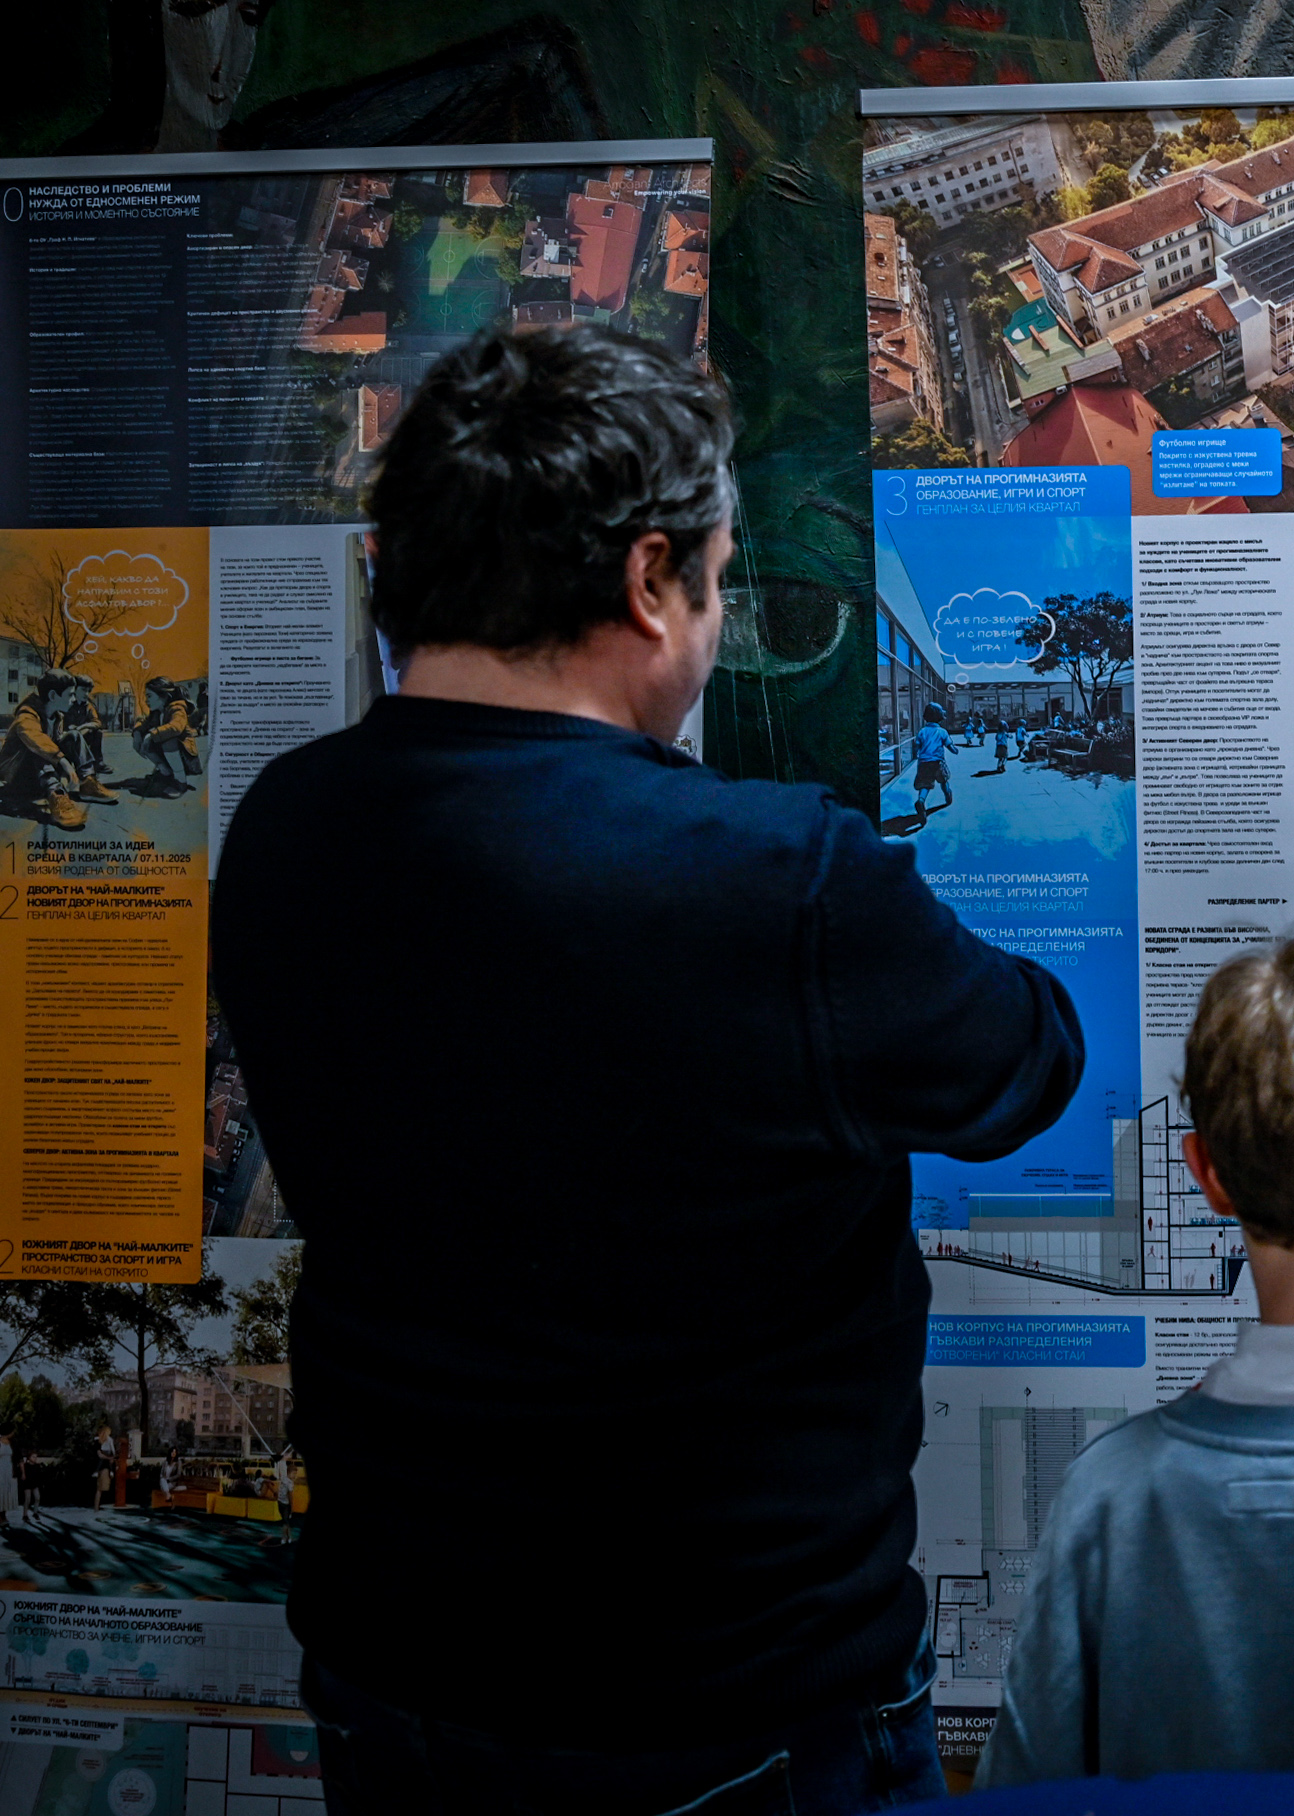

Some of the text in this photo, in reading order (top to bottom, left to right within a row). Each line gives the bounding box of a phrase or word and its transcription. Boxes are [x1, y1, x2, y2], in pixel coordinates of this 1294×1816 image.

[29, 186, 99, 195] НАСЛЕДСТВО
[113, 184, 171, 193] ПРОБЛЕМИ
[29, 195, 200, 209] НУЖДА ОТ ЕДНОСМЕНЕН РЕЖИМ
[29, 211, 74, 221] ИСТОРИЯ
[85, 209, 139, 219] МОМЕНТНО
[141, 207, 199, 218] СЪСТОЯНИЕ
[916, 473, 1087, 486] ДВОРЪТ НА ПРОГИМНАЗИЯТА
[887, 476, 908, 515] 3
[916, 488, 1086, 500] ОБРАЗОВАНИЕ, ИГРИ И СПОРТ
[917, 502, 1080, 515] ГЕНПЛАН ЗА ЦЕЛИЯ КВАРТАЛ
[973, 615, 1038, 623] ПО-ЗЕЛЕНО
[978, 630, 1024, 638] ПОВЕЧЕ
[28, 841, 154, 851] РАБОТИЛНИЦИ ЗА ИДЕИ
[5, 842, 16, 874] 1
[27, 853, 66, 862] СРЕЩА
[68, 853, 76, 862] В
[78, 854, 132, 862] КВАРТАЛА
[140, 854, 191, 862] 07.11.2025
[28, 866, 187, 876] ВИЗИЯ РОДЕНА ОТ ОБЩНОСТТА
[27, 886, 69, 895] ДВОРЪТ
[0, 885, 19, 919] 2
[27, 898, 66, 907] НОВИЯТ
[68, 898, 95, 908] ДВОР
[110, 899, 192, 907] ПРОГИМНАЗИЯТА
[22, 1240, 68, 1249] ЮЖНИЯТ
[69, 1241, 97, 1251] ДВОР
[98, 1242, 112, 1250] НА
[22, 1253, 182, 1264] ПРОСТРАНСТВО ЗА СПОРТ И ИГРА
[22, 1265, 61, 1274] КЛАСНИ
[63, 1266, 88, 1275] СТАИ
[104, 1268, 148, 1277] ОТКРИТО
[929, 1322, 1130, 1332] НОВ КОРПУС НА ПРОГИМНАЗИЯТА
[928, 1336, 1092, 1347] ГЪВКАВИ РАЗПРЕДЕЛЕНИЯ
[1004, 1351, 1051, 1360] КЛАСНИ
[1054, 1351, 1086, 1360] СТАИ
[12, 1613, 203, 1633] СЪРЦЕТО НА НАЧАЛНОТО ОБРАЗОВАНИЕ
[938, 1718, 996, 1728] НОВ КОРП
